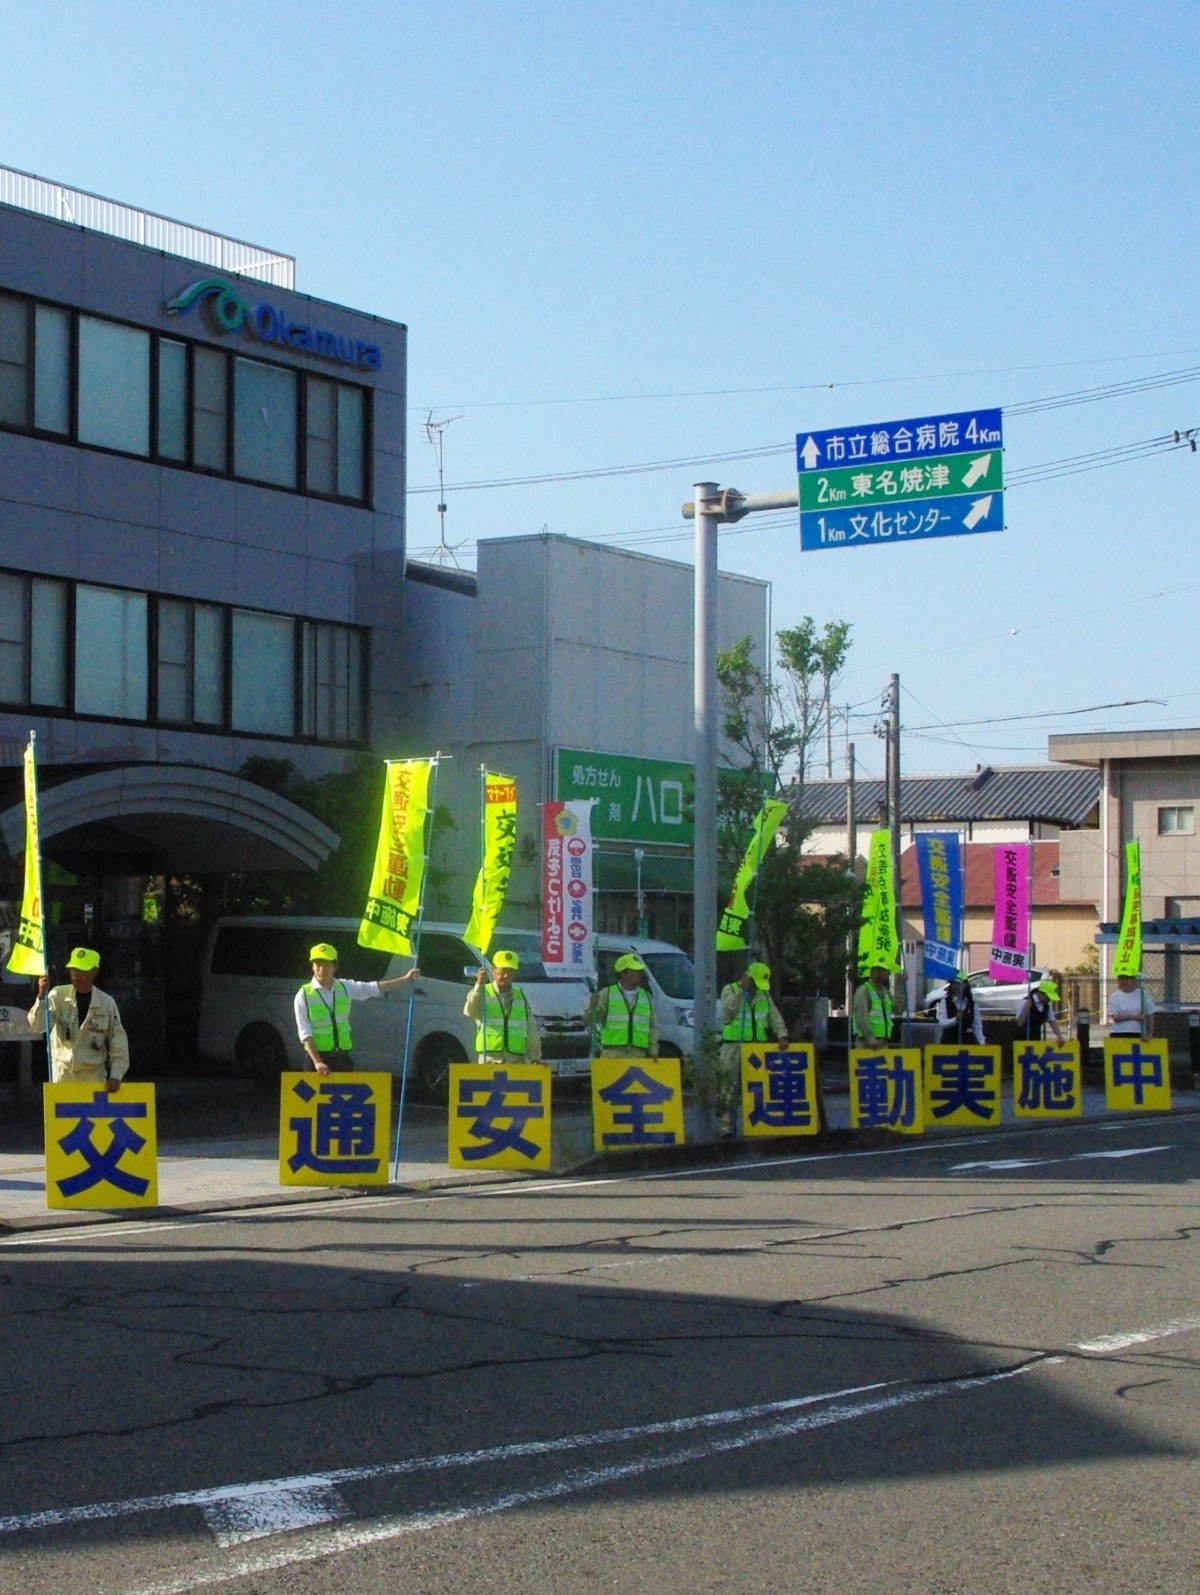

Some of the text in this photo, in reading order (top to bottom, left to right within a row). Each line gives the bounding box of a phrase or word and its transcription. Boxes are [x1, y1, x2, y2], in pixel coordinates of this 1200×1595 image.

[255, 303, 382, 371] Okamura
[825, 418, 1000, 461] 市立総合病院 4Km
[817, 464, 950, 503] 2Km 東名焼津
[818, 508, 951, 542] 1Km 文化センター
[573, 764, 622, 788] 処方せん
[54, 1091, 150, 1197] 交
[287, 1078, 380, 1174] 通
[457, 1071, 544, 1161] 安
[598, 1065, 676, 1145] 全
[747, 1051, 811, 1127] 運
[855, 1055, 916, 1127] 動
[930, 1049, 995, 1120] 実
[1018, 1046, 1076, 1110] 施
[1113, 1043, 1163, 1105] 中
